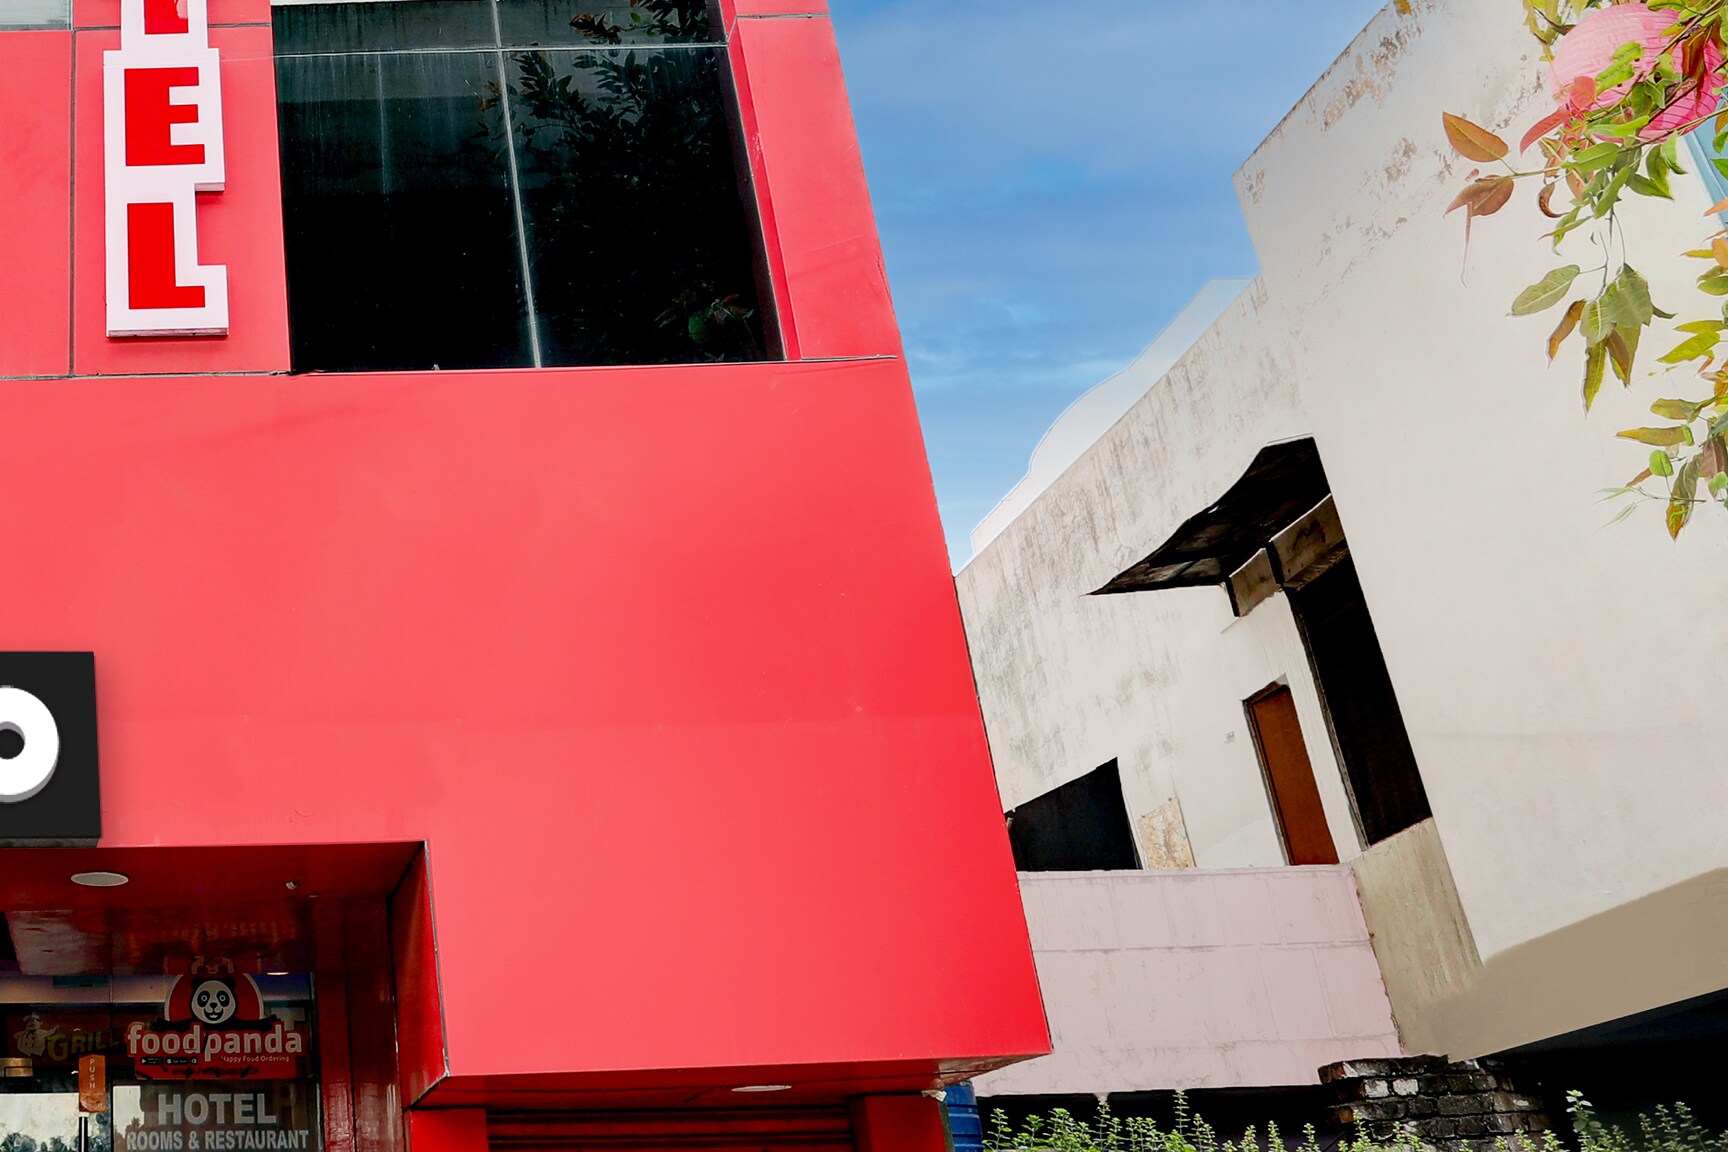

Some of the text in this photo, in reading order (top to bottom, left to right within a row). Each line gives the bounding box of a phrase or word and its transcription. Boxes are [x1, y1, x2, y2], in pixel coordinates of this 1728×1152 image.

[127, 1023, 303, 1062] foodpanda
[88, 1058, 97, 1089] PUSH
[260, 1055, 290, 1064] Ordering
[158, 1093, 277, 1125] HOTEL
[126, 1129, 309, 1151] ROOMS & RESTAURANT
